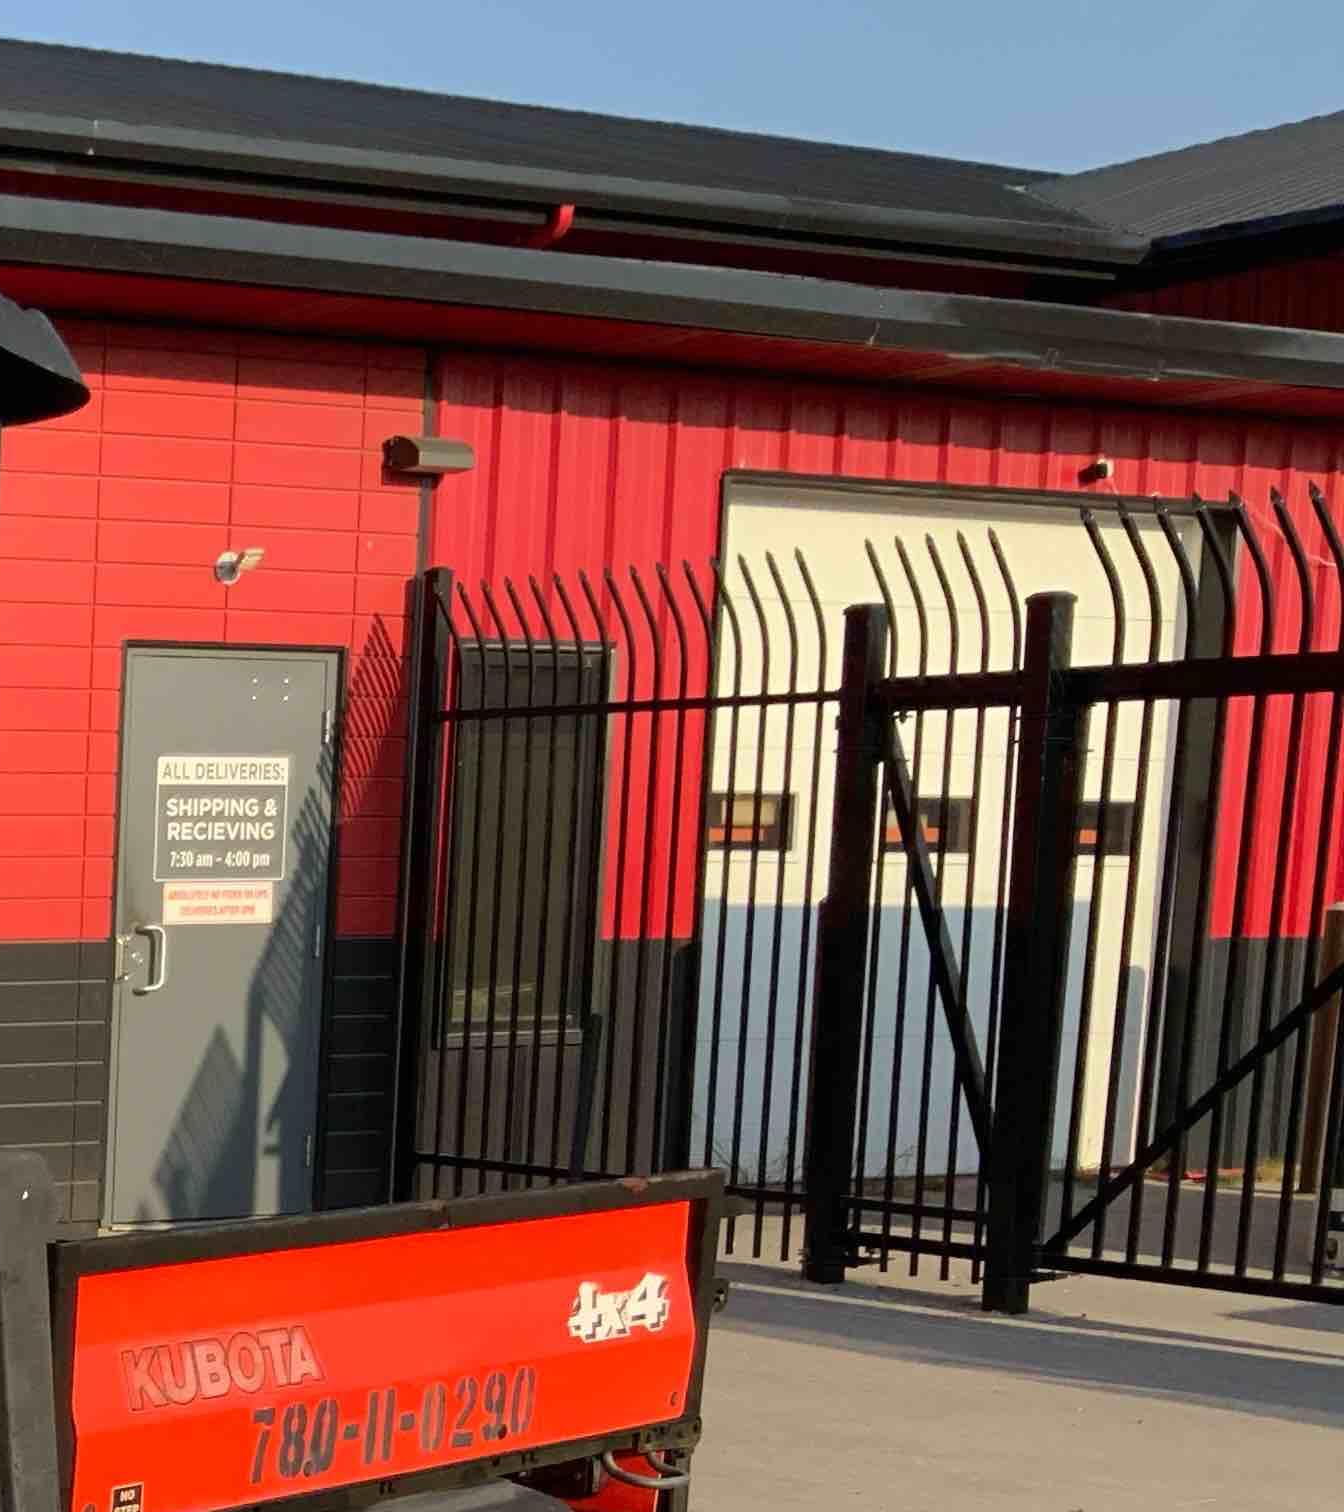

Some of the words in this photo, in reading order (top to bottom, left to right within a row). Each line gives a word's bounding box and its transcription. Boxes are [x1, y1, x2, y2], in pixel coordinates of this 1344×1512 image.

[162, 763, 190, 780] ALL
[196, 763, 285, 781] DELIVERIES:
[166, 798, 259, 817] SHIPPING
[264, 798, 277, 817] &
[167, 822, 275, 841] RECIEVING
[170, 851, 194, 868] 7:30
[196, 853, 213, 868] am
[225, 851, 250, 868] 4:00
[252, 853, 270, 869] pm
[568, 1272, 670, 1343] 4x4
[121, 1326, 325, 1413] KUBOTA
[120, 1489, 136, 1502] NO
